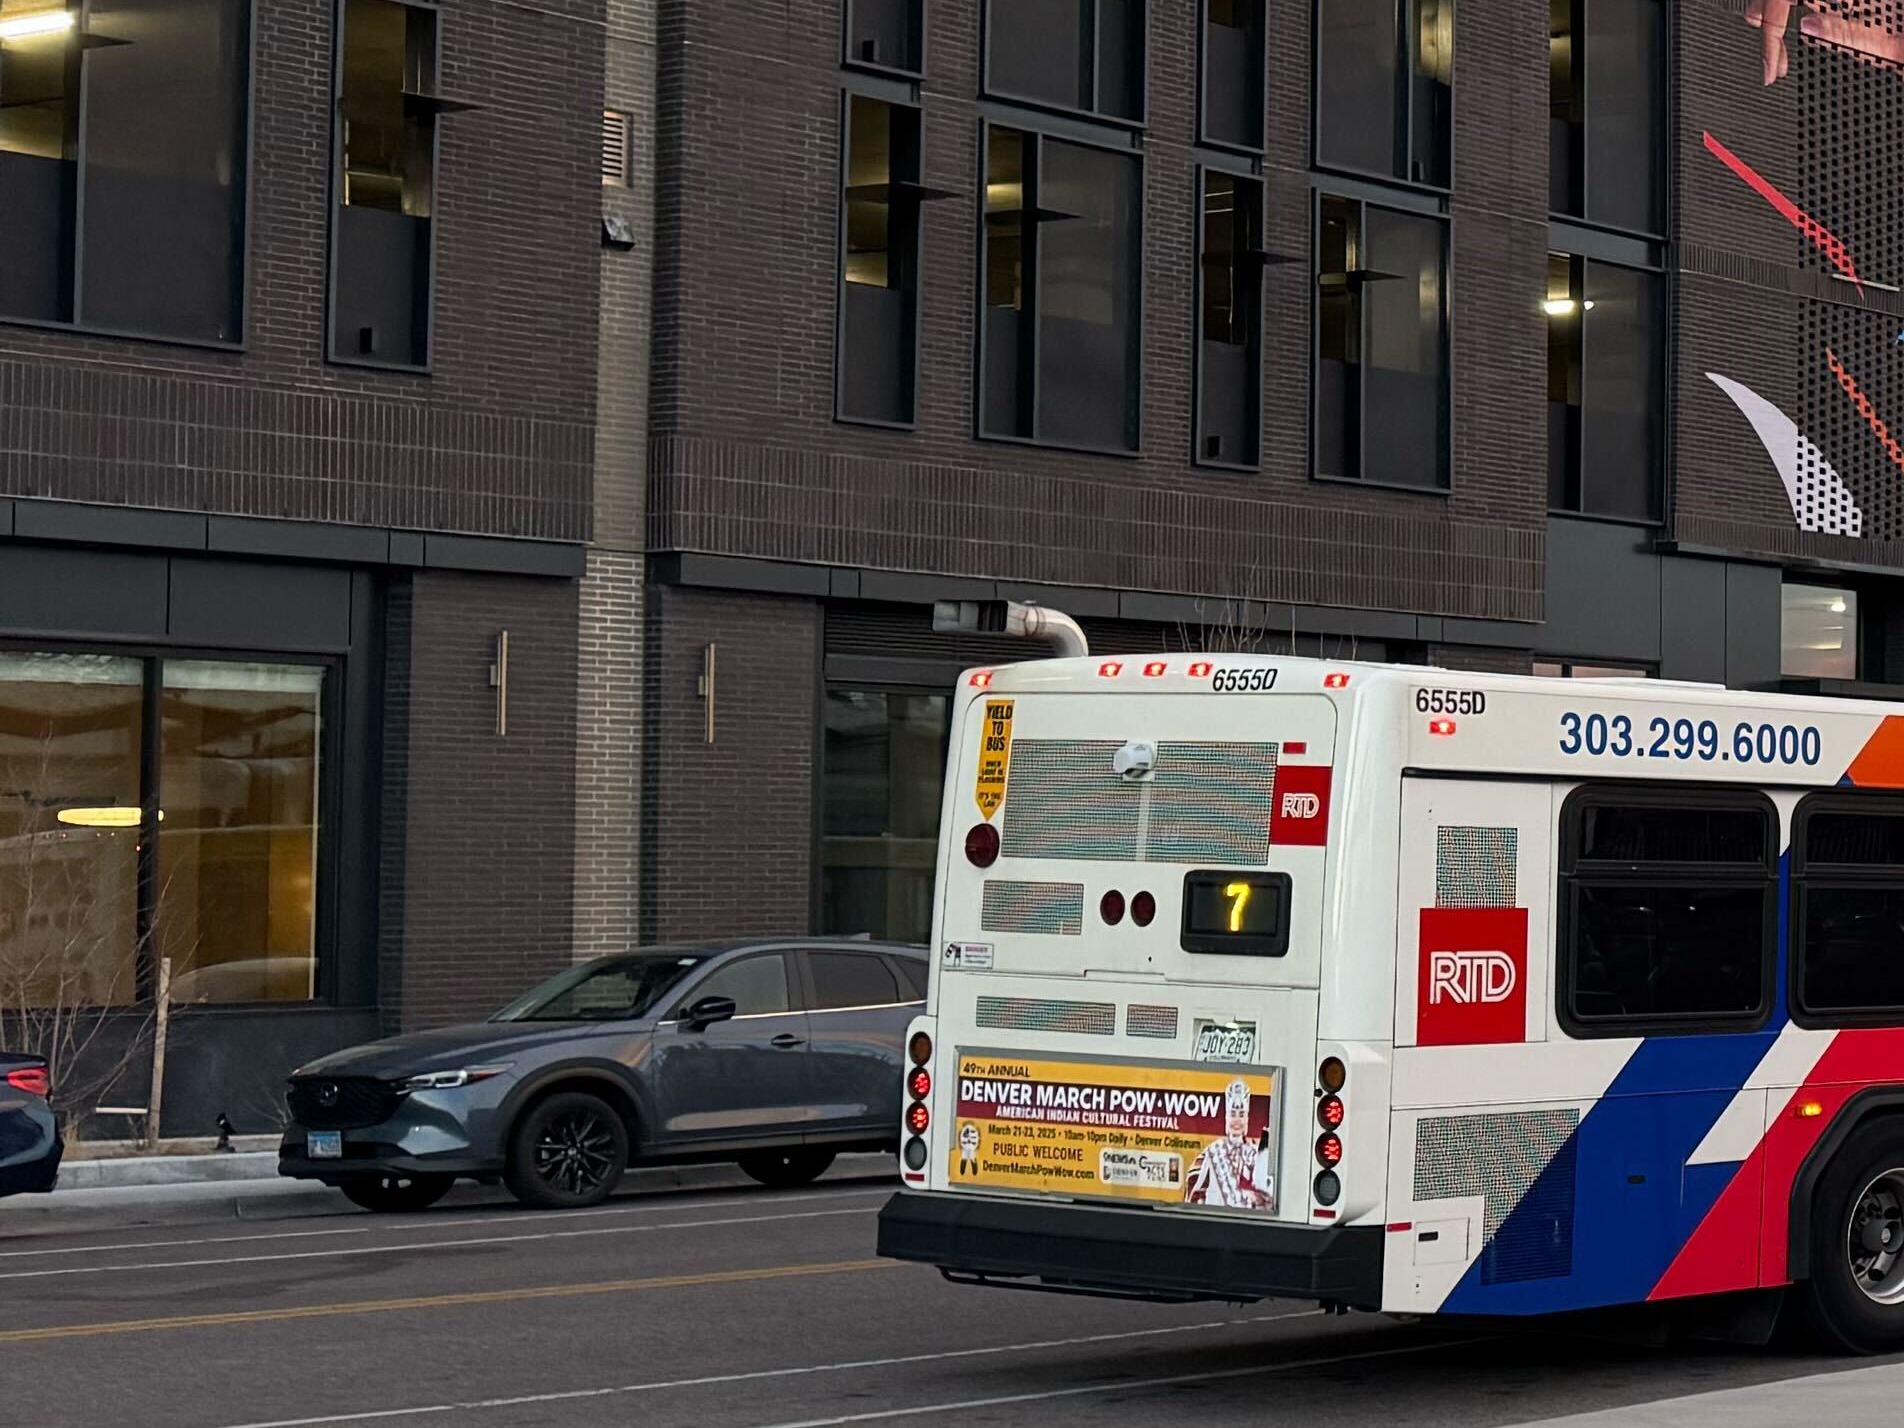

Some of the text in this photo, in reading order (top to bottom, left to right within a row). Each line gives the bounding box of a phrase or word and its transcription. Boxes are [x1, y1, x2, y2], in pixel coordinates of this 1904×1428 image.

[1212, 668, 1279, 692] 6555D
[986, 705, 1013, 720] YIELD
[1415, 688, 1487, 715] 6555D
[992, 721, 1004, 736] TO
[1559, 711, 1822, 766] 303.299.6000
[986, 736, 1006, 751] BUS
[1281, 793, 1320, 819] RTD
[1226, 883, 1250, 932] 7
[1430, 950, 1517, 1005] RTD
[987, 1065, 1031, 1078] ANNUAL
[961, 1079, 1032, 1106] DENVER
[1036, 1084, 1106, 1111] MARCH
[995, 1105, 1180, 1130] AMERICAN INDIAN CULTURAL FESTIVAL
[988, 1123, 1012, 1136] March
[1037, 1127, 1057, 1139] 2025
[1108, 1132, 1129, 1147] Daily
[1135, 1133, 1162, 1147] Denver
[1164, 1136, 1201, 1149] Coliseum
[993, 1142, 1029, 1158] PUBLIC
[1032, 1144, 1084, 1162] WELCOME
[982, 1159, 1095, 1180] DenverMarchPowWow.com
